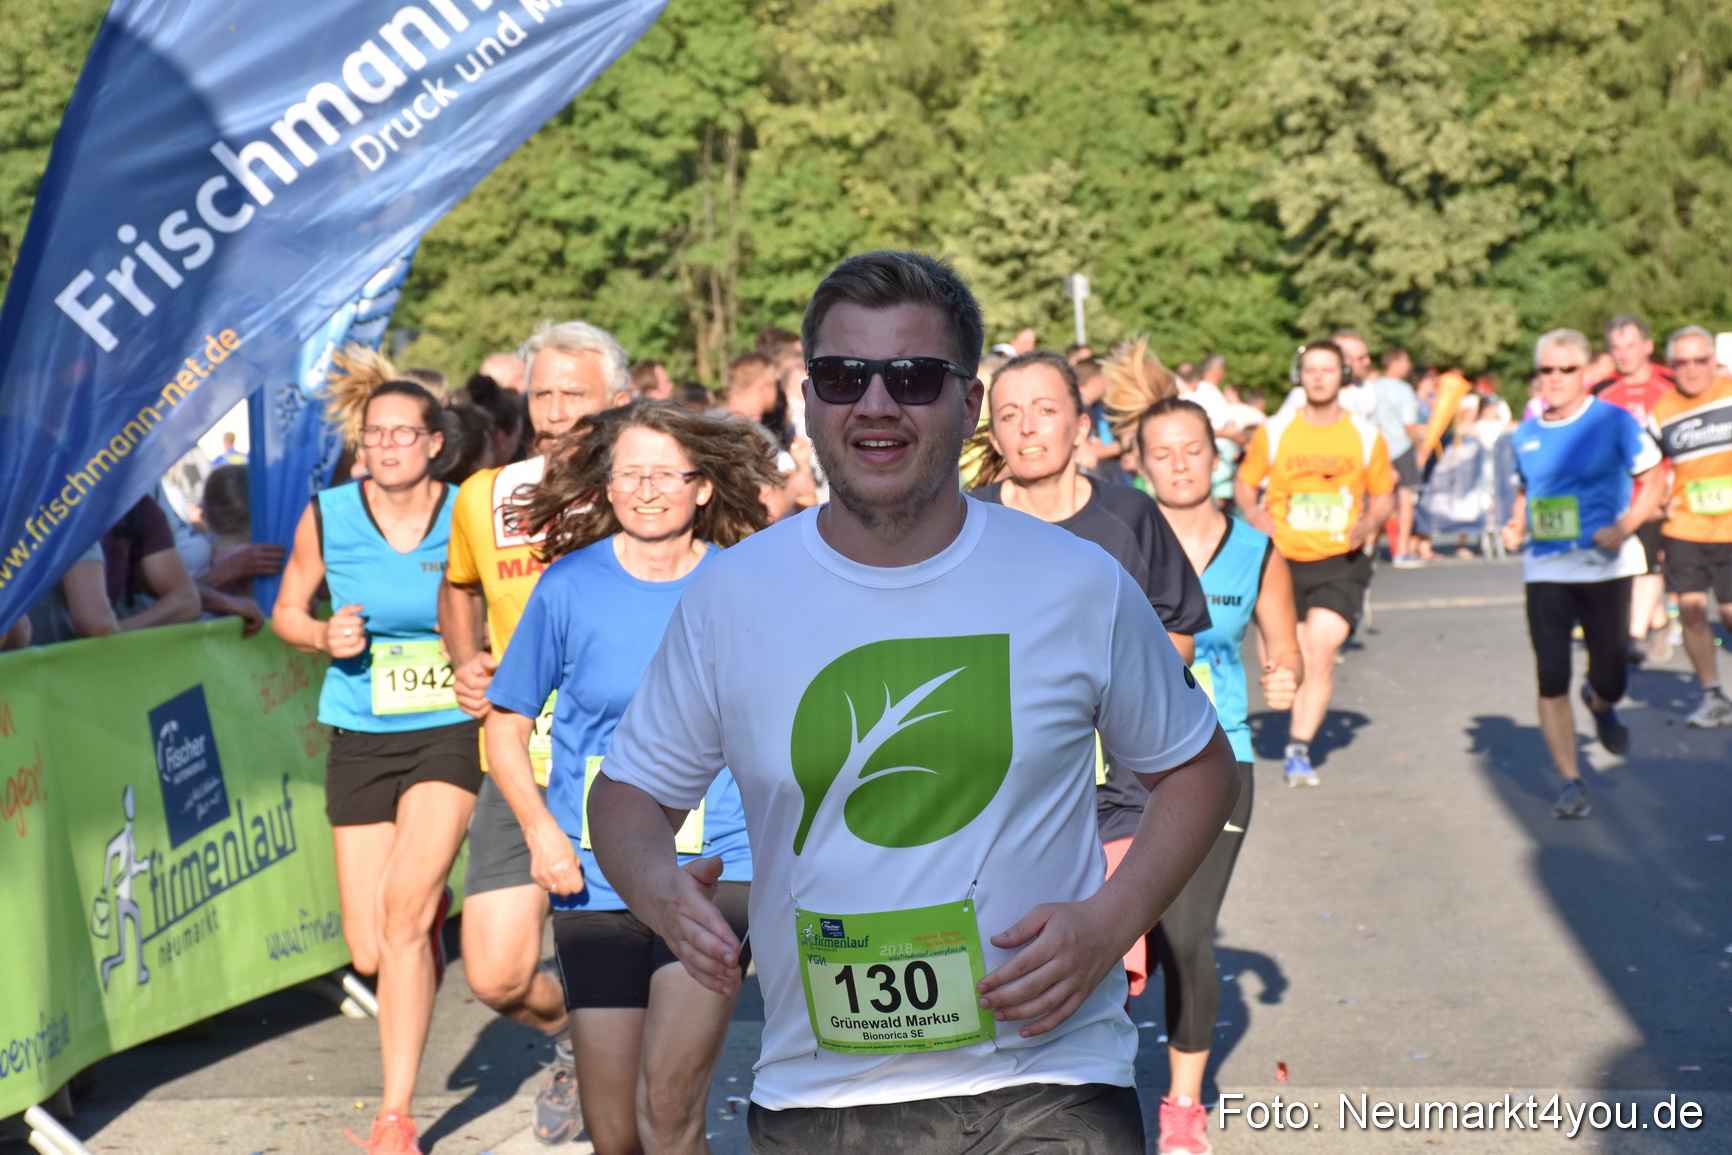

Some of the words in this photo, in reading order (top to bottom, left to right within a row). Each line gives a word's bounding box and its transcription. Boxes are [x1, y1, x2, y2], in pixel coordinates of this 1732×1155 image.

[350, 77, 459, 172] Druck
[455, 10, 528, 83] und
[386, 664, 454, 692] 1942
[149, 772, 297, 932] firmenlauf
[157, 903, 220, 968] neumarkt
[814, 934, 870, 949] firmenlauf
[880, 943, 913, 957] 2018
[834, 960, 939, 1014] 130
[830, 1010, 902, 1029] Grünewald
[905, 1010, 960, 1028] Markus
[862, 1030, 909, 1041] Bionorica
[910, 1029, 925, 1038] SE
